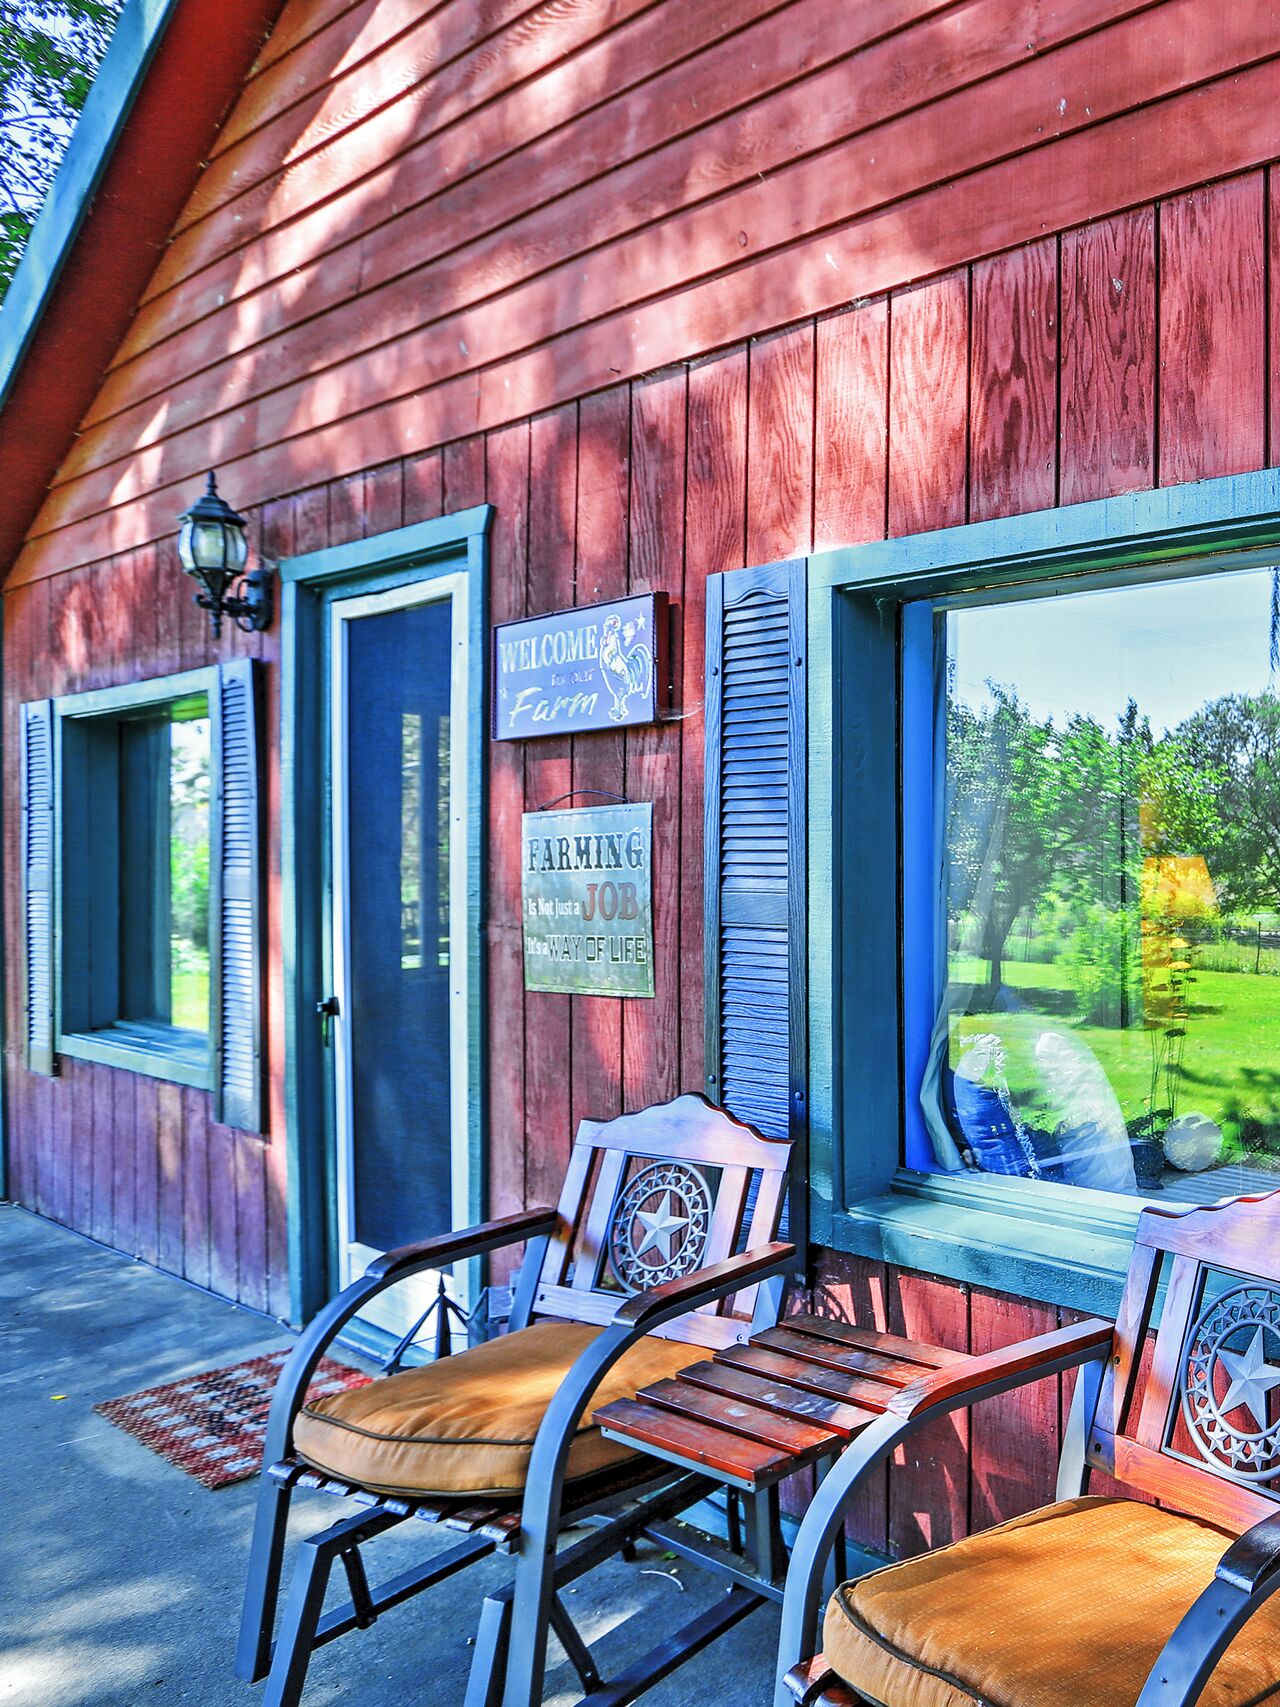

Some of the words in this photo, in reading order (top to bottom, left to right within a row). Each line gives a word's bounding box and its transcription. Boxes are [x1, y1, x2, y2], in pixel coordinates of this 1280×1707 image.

[499, 624, 598, 673] WELCOME
[508, 687, 598, 728] Farm
[527, 829, 645, 873] FARMING
[527, 898, 537, 916] Is
[538, 898, 554, 916] Not
[555, 898, 573, 919] Just
[574, 902, 580, 915] a
[581, 880, 639, 922] JOB
[527, 936, 543, 955] It's
[542, 942, 549, 955] a
[547, 934, 582, 962] WAY
[585, 935, 605, 963] OF
[609, 934, 647, 965] LIFE
